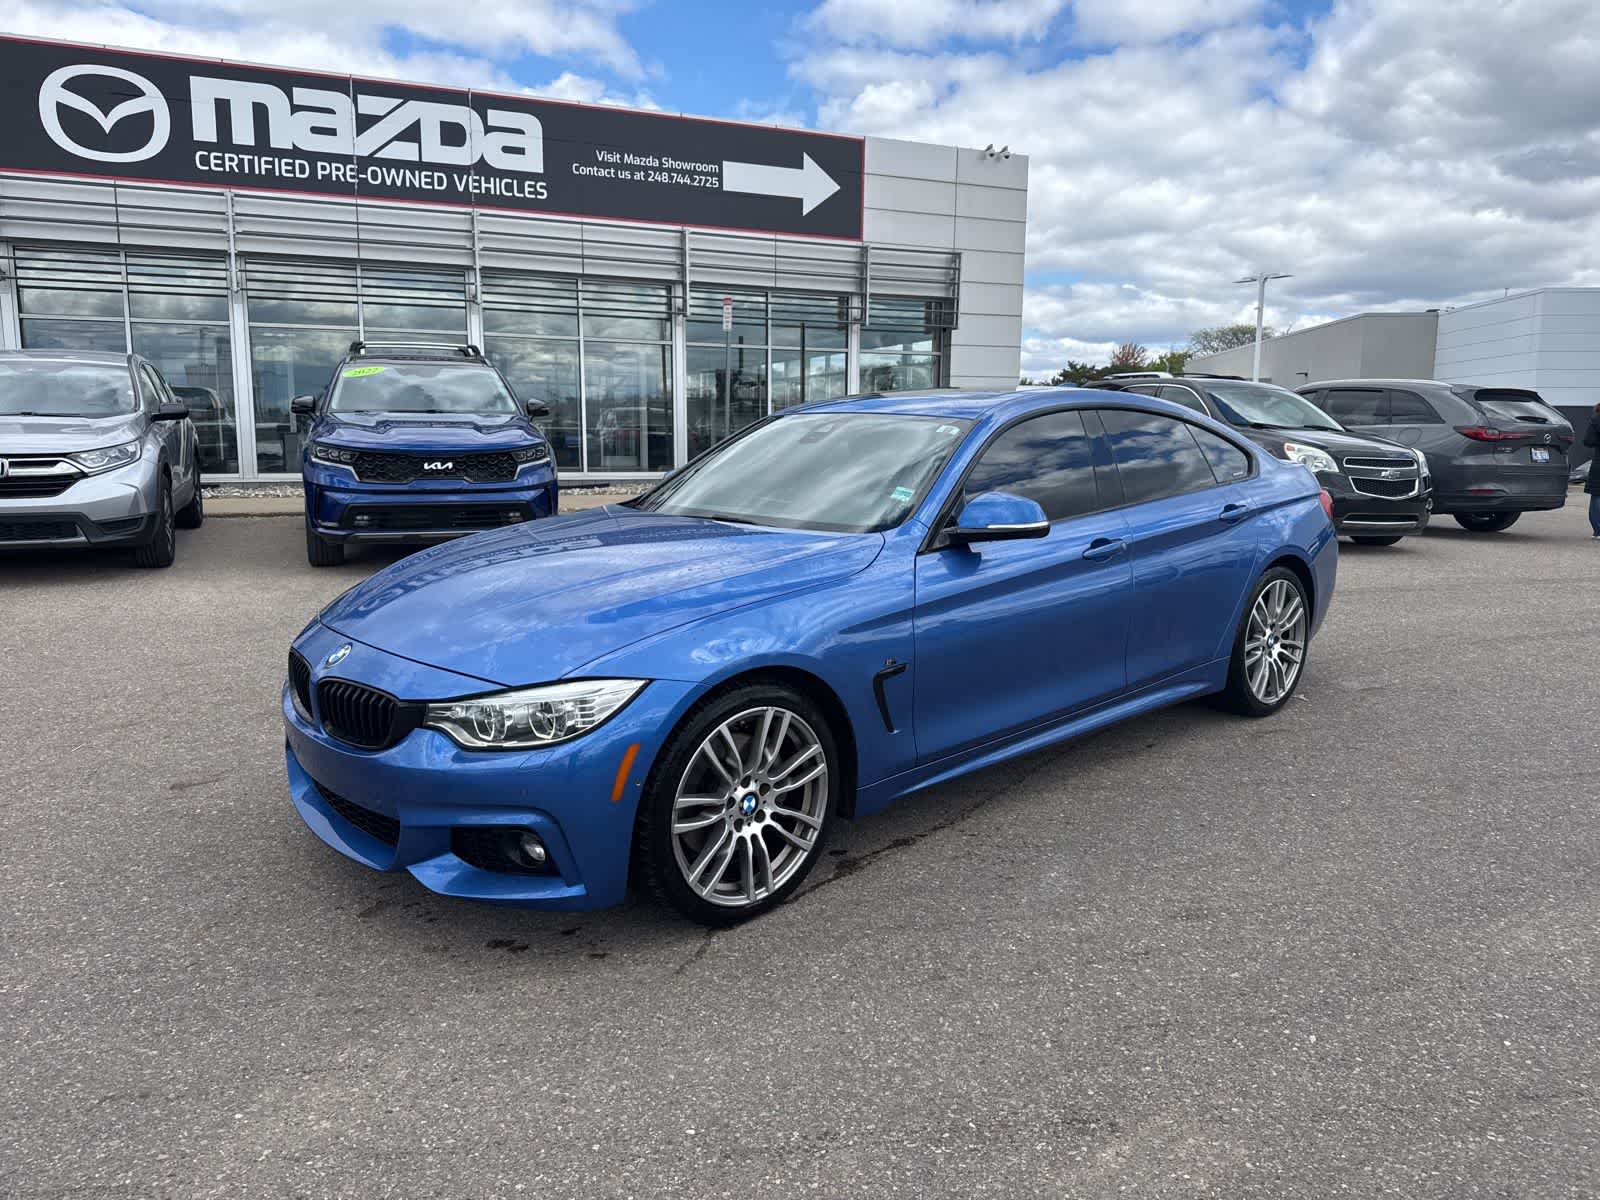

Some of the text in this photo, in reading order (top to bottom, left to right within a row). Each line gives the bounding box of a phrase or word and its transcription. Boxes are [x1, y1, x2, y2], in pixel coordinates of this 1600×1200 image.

[595, 149, 719, 173] Visit Mazda Showroom
[195, 150, 548, 200] CERTIFIED PRE-OWNED VEHICLES
[572, 163, 719, 188] Contact us at 248.744.2725
